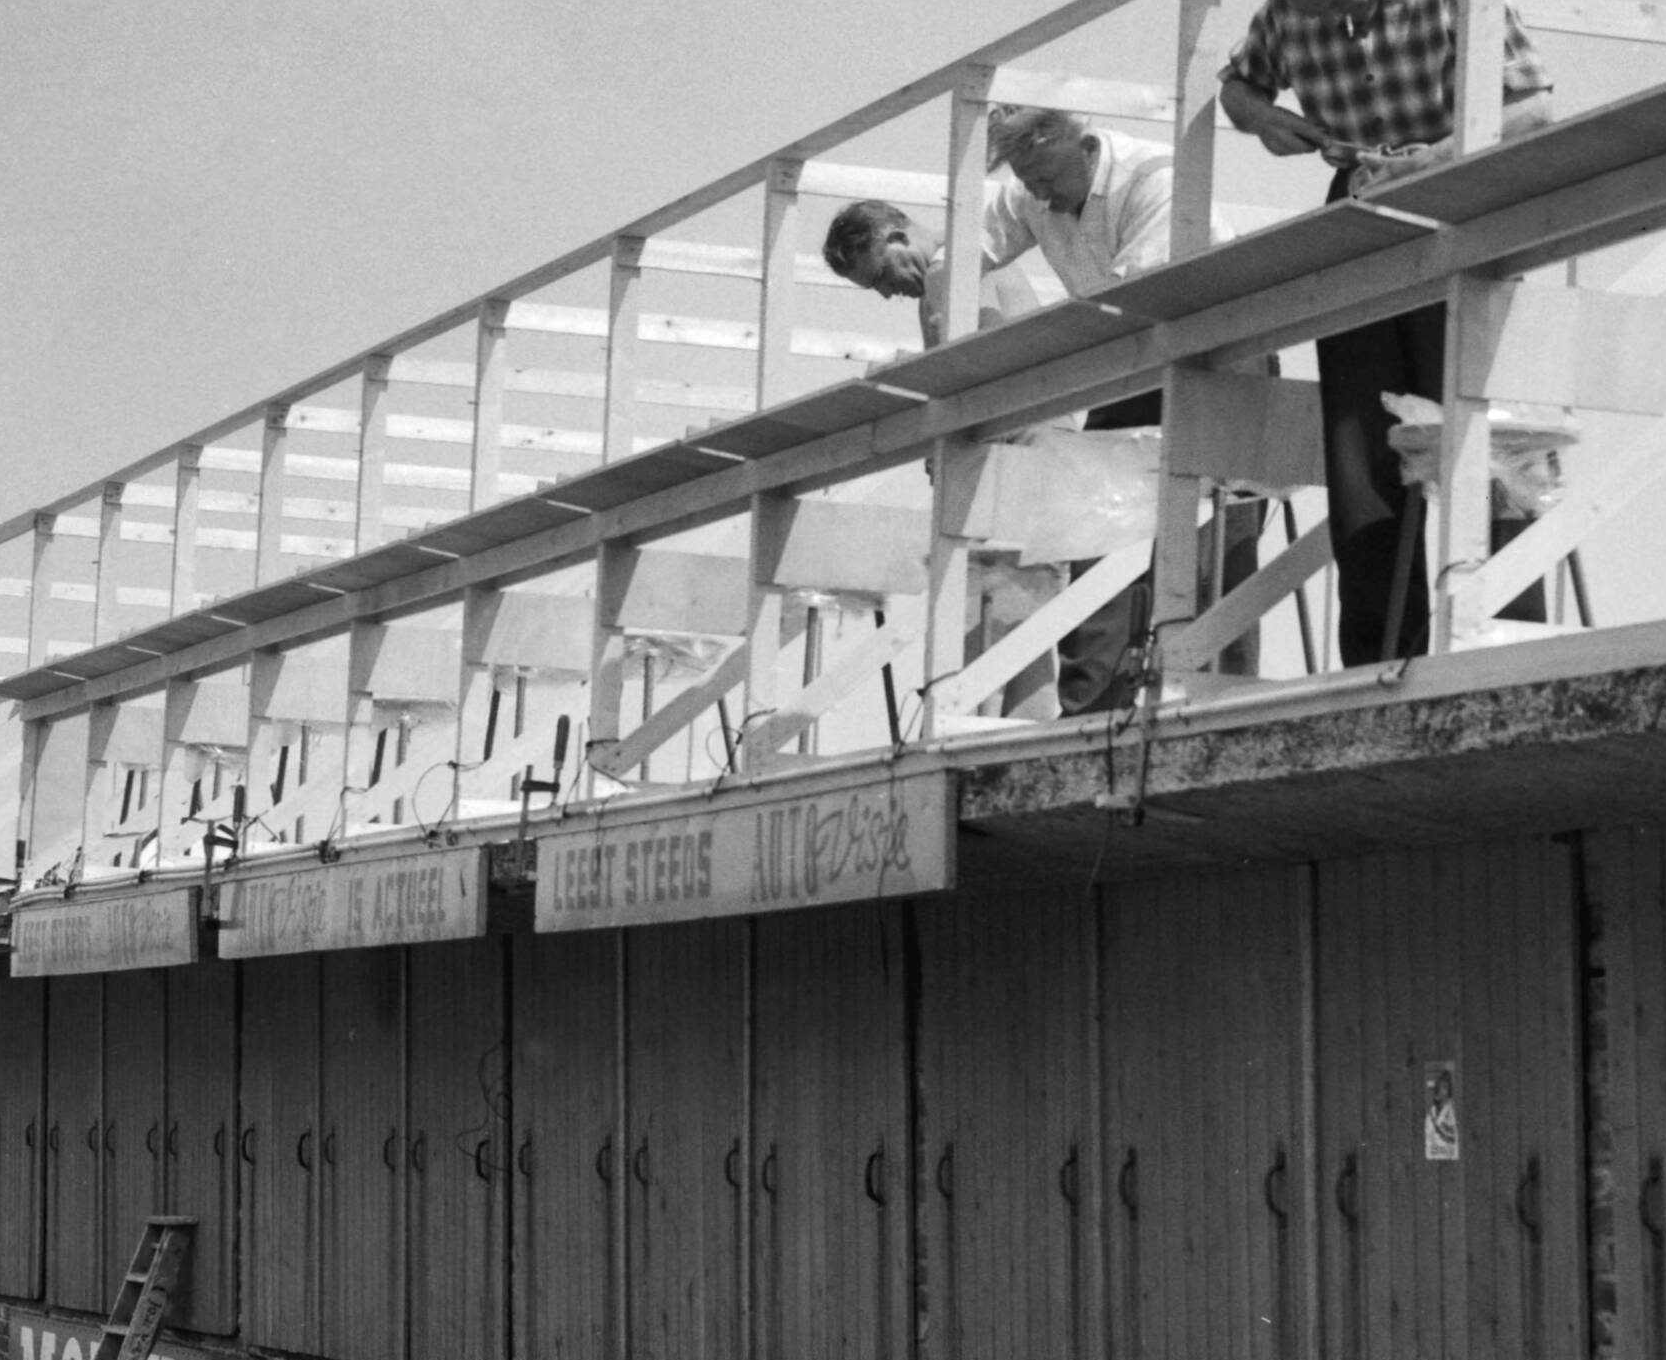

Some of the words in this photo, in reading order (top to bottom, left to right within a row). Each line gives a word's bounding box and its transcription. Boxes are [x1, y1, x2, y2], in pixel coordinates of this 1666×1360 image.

[373, 866, 445, 930] ACTUEEL
[554, 843, 616, 911] LEEST
[625, 831, 712, 905] STEEDS
